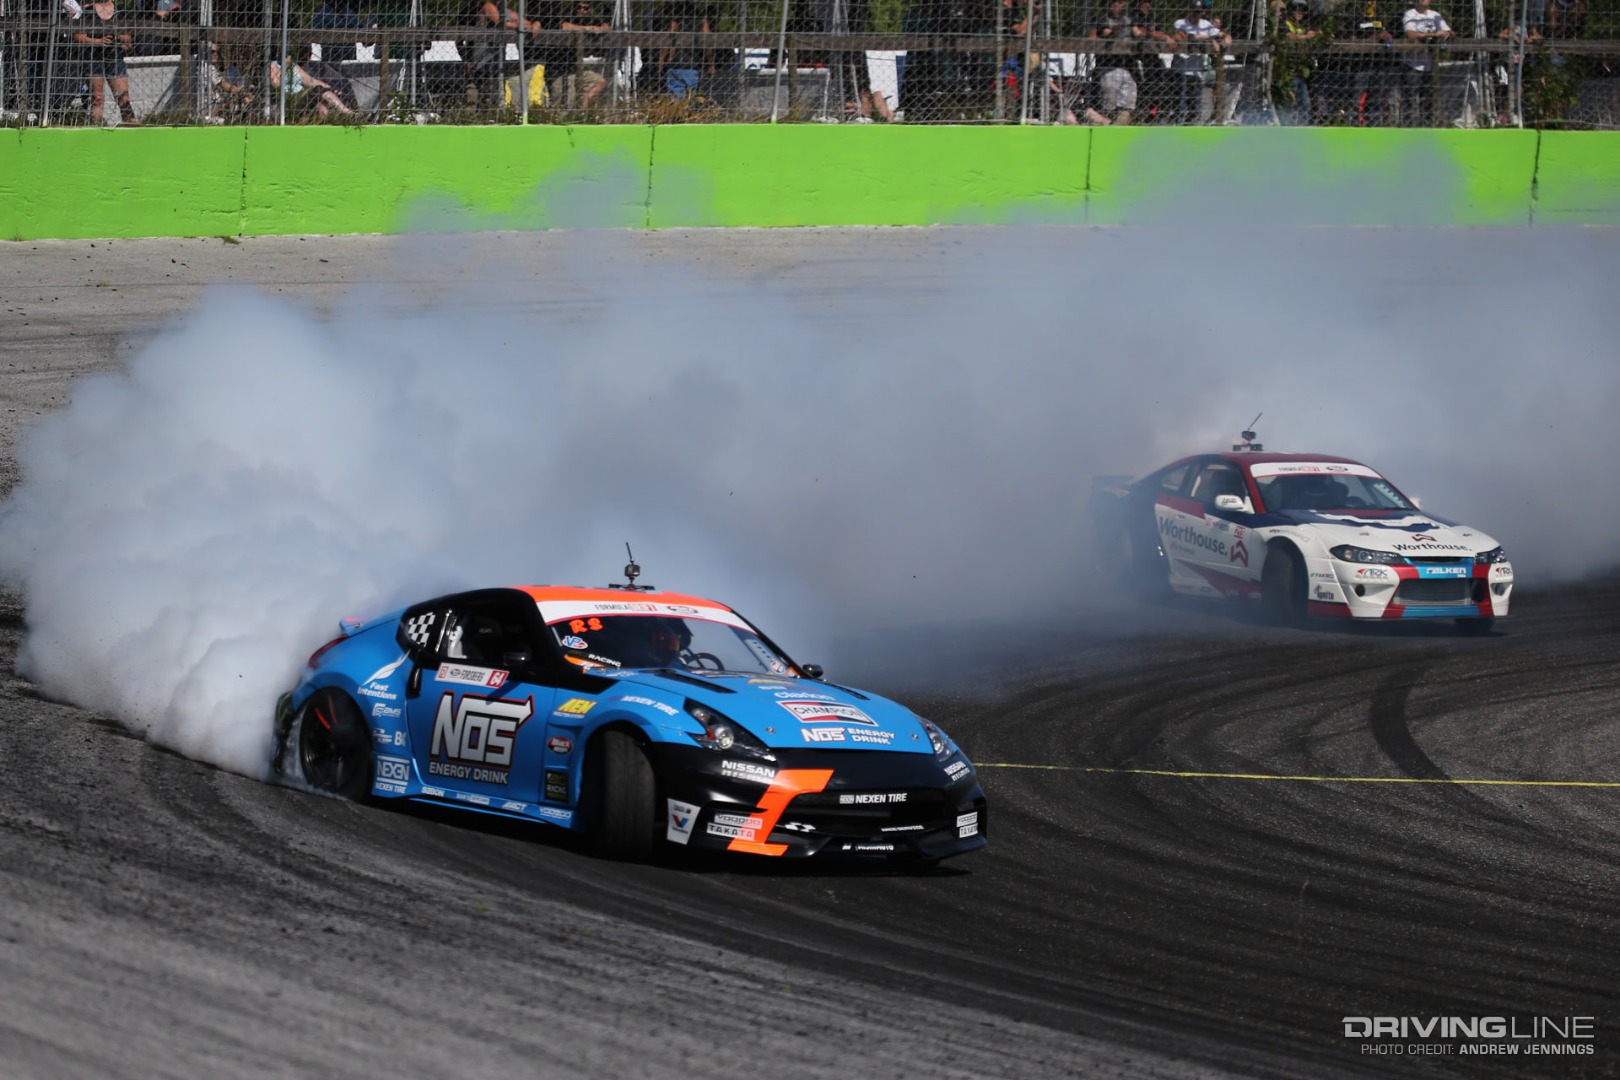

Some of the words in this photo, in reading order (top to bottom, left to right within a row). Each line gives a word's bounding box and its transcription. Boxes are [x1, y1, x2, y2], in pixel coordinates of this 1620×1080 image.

[1160, 517, 1228, 556] Worthouse.
[1393, 543, 1472, 552] Worthouse.
[588, 653, 621, 667] RACING
[369, 681, 389, 692] Fast
[358, 687, 397, 700] Intentions
[774, 691, 836, 701] Clarion
[620, 695, 655, 706] NEXEN
[653, 700, 680, 716] TIRE
[794, 706, 866, 717] CHAMPION
[430, 691, 533, 768] NOS
[801, 727, 846, 742] NOS
[848, 728, 896, 739] ENERGY
[852, 735, 892, 745] DRINK
[429, 761, 472, 779] ENERGY
[473, 769, 509, 785] DRINK
[722, 760, 776, 778] NISSAN
[375, 782, 394, 792] NEXEN
[394, 785, 407, 794] TIRE
[856, 795, 886, 804] NEXEN
[888, 793, 907, 802] TIRE
[708, 824, 753, 838] TAKATA
